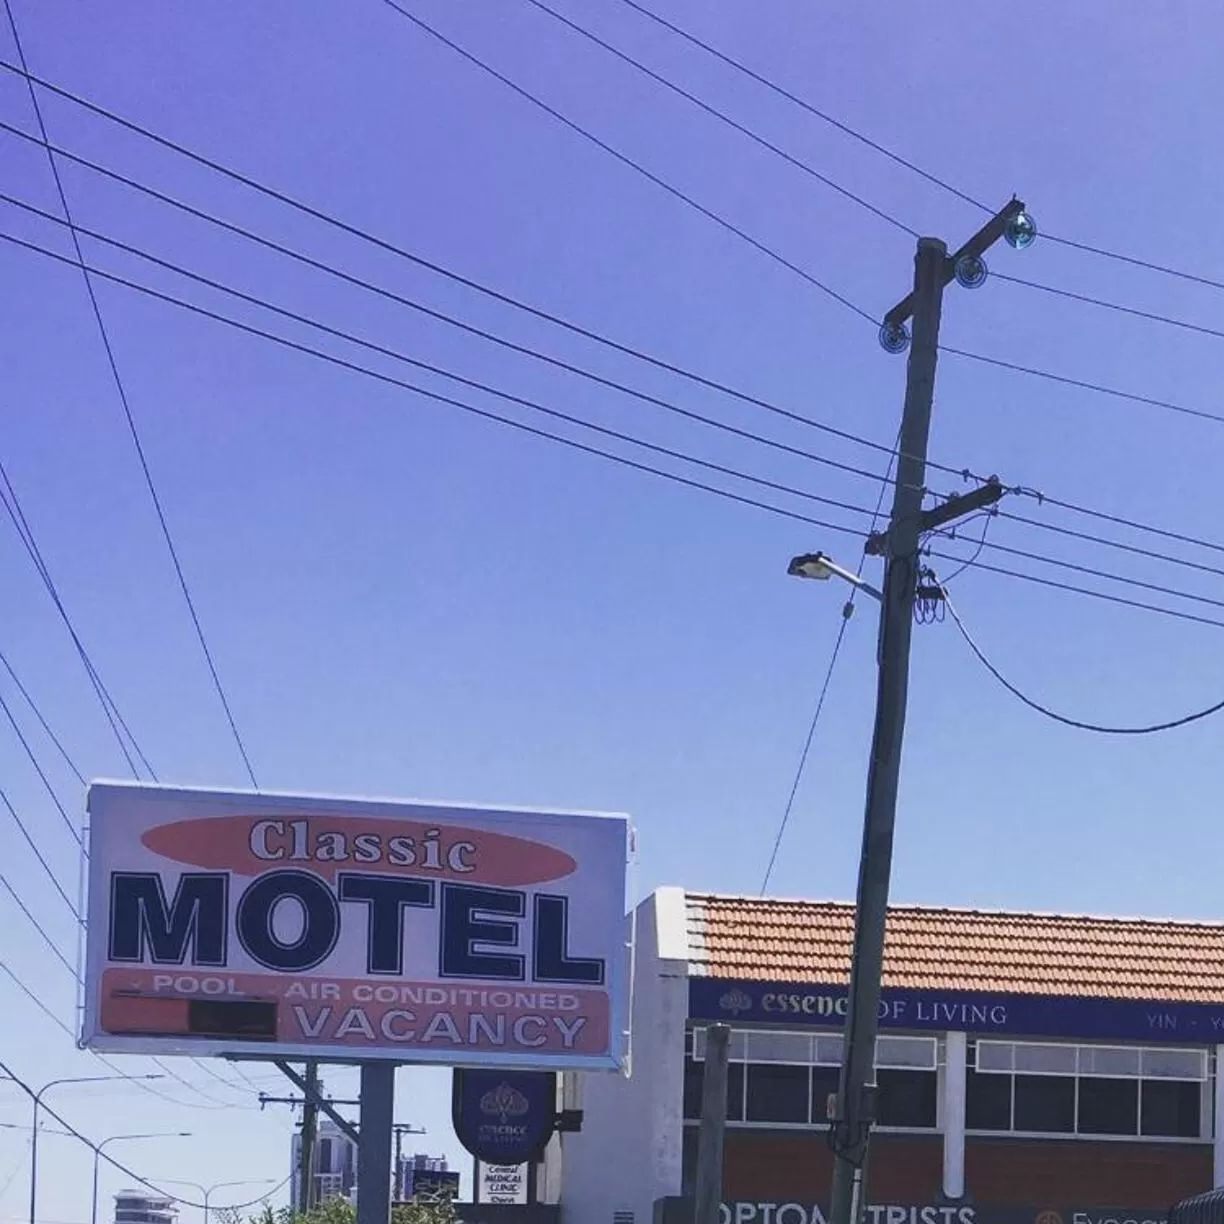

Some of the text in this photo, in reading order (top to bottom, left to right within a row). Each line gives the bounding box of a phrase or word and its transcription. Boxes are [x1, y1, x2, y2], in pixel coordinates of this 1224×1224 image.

[249, 819, 476, 873] Classic
[107, 869, 605, 985] MOTEL
[153, 975, 246, 995] POOL
[284, 983, 581, 1011] AIR CONDITIONED
[762, 993, 848, 1018] essenc
[916, 1003, 1008, 1024] LIVING
[1148, 1015, 1177, 1029] YIN
[292, 1004, 588, 1049] VACANCY
